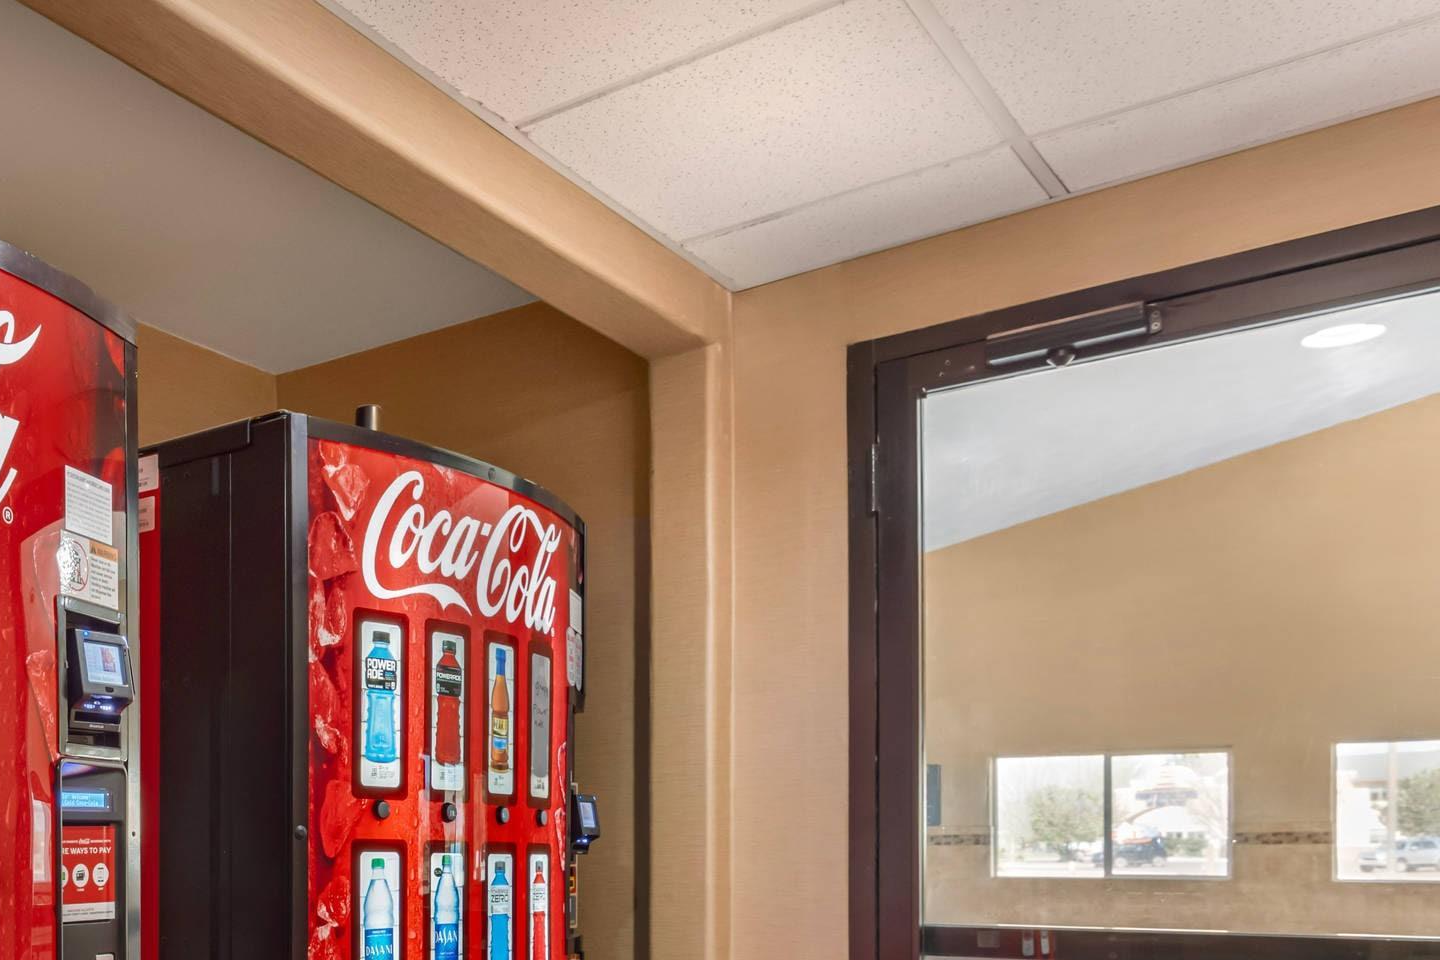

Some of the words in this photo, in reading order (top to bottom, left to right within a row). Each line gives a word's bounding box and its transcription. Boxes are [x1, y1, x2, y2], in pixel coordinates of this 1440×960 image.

[362, 470, 561, 634] Coca-Cola
[367, 658, 396, 671] POWER
[367, 669, 384, 680] ADE
[99, 846, 112, 854] PAY
[366, 943, 393, 957] DASANI
